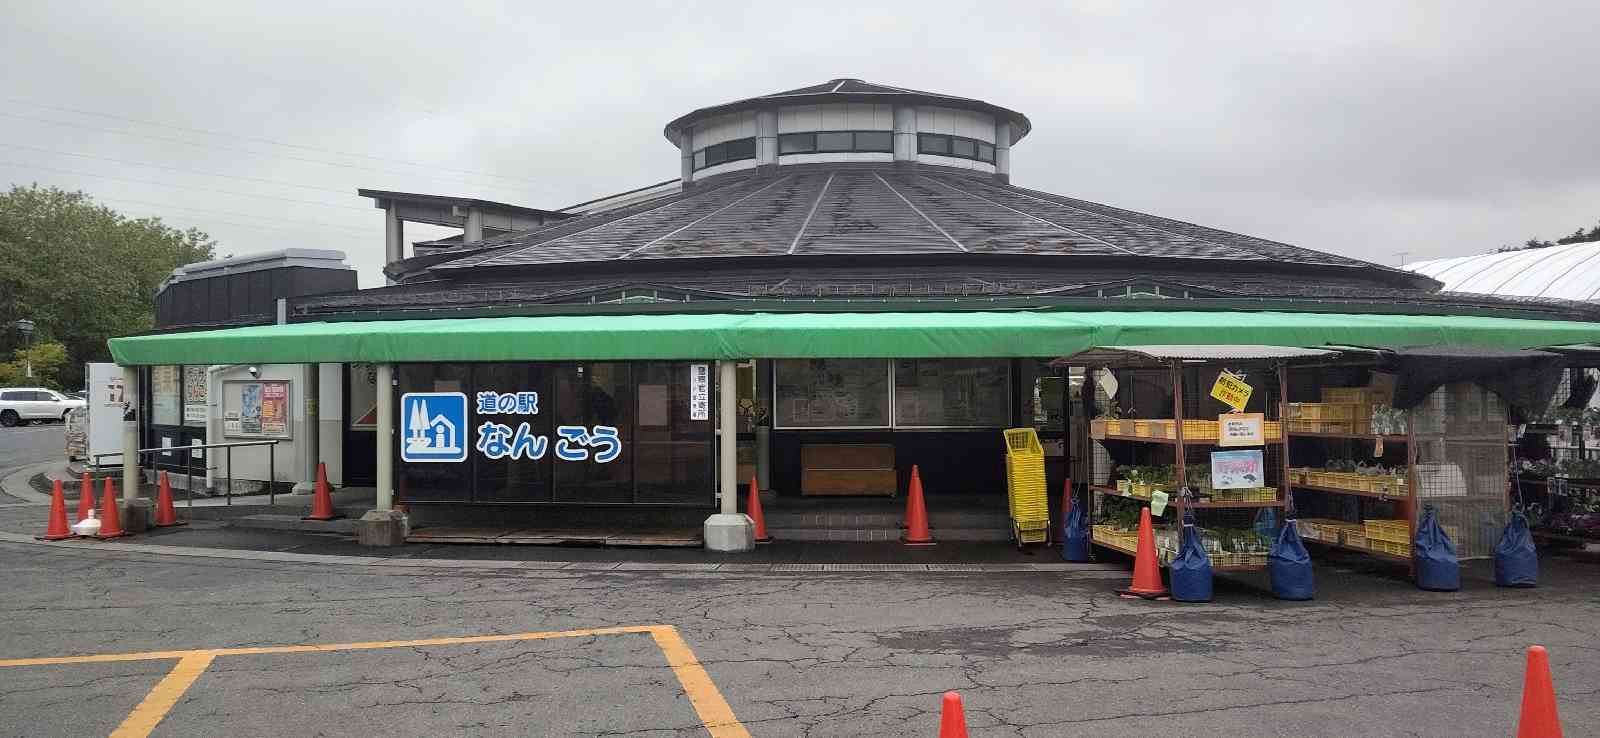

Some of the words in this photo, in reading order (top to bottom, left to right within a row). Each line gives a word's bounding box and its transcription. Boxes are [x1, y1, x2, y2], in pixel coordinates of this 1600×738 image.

[477, 391, 538, 415] 道の駅
[477, 421, 622, 463] なんごう
